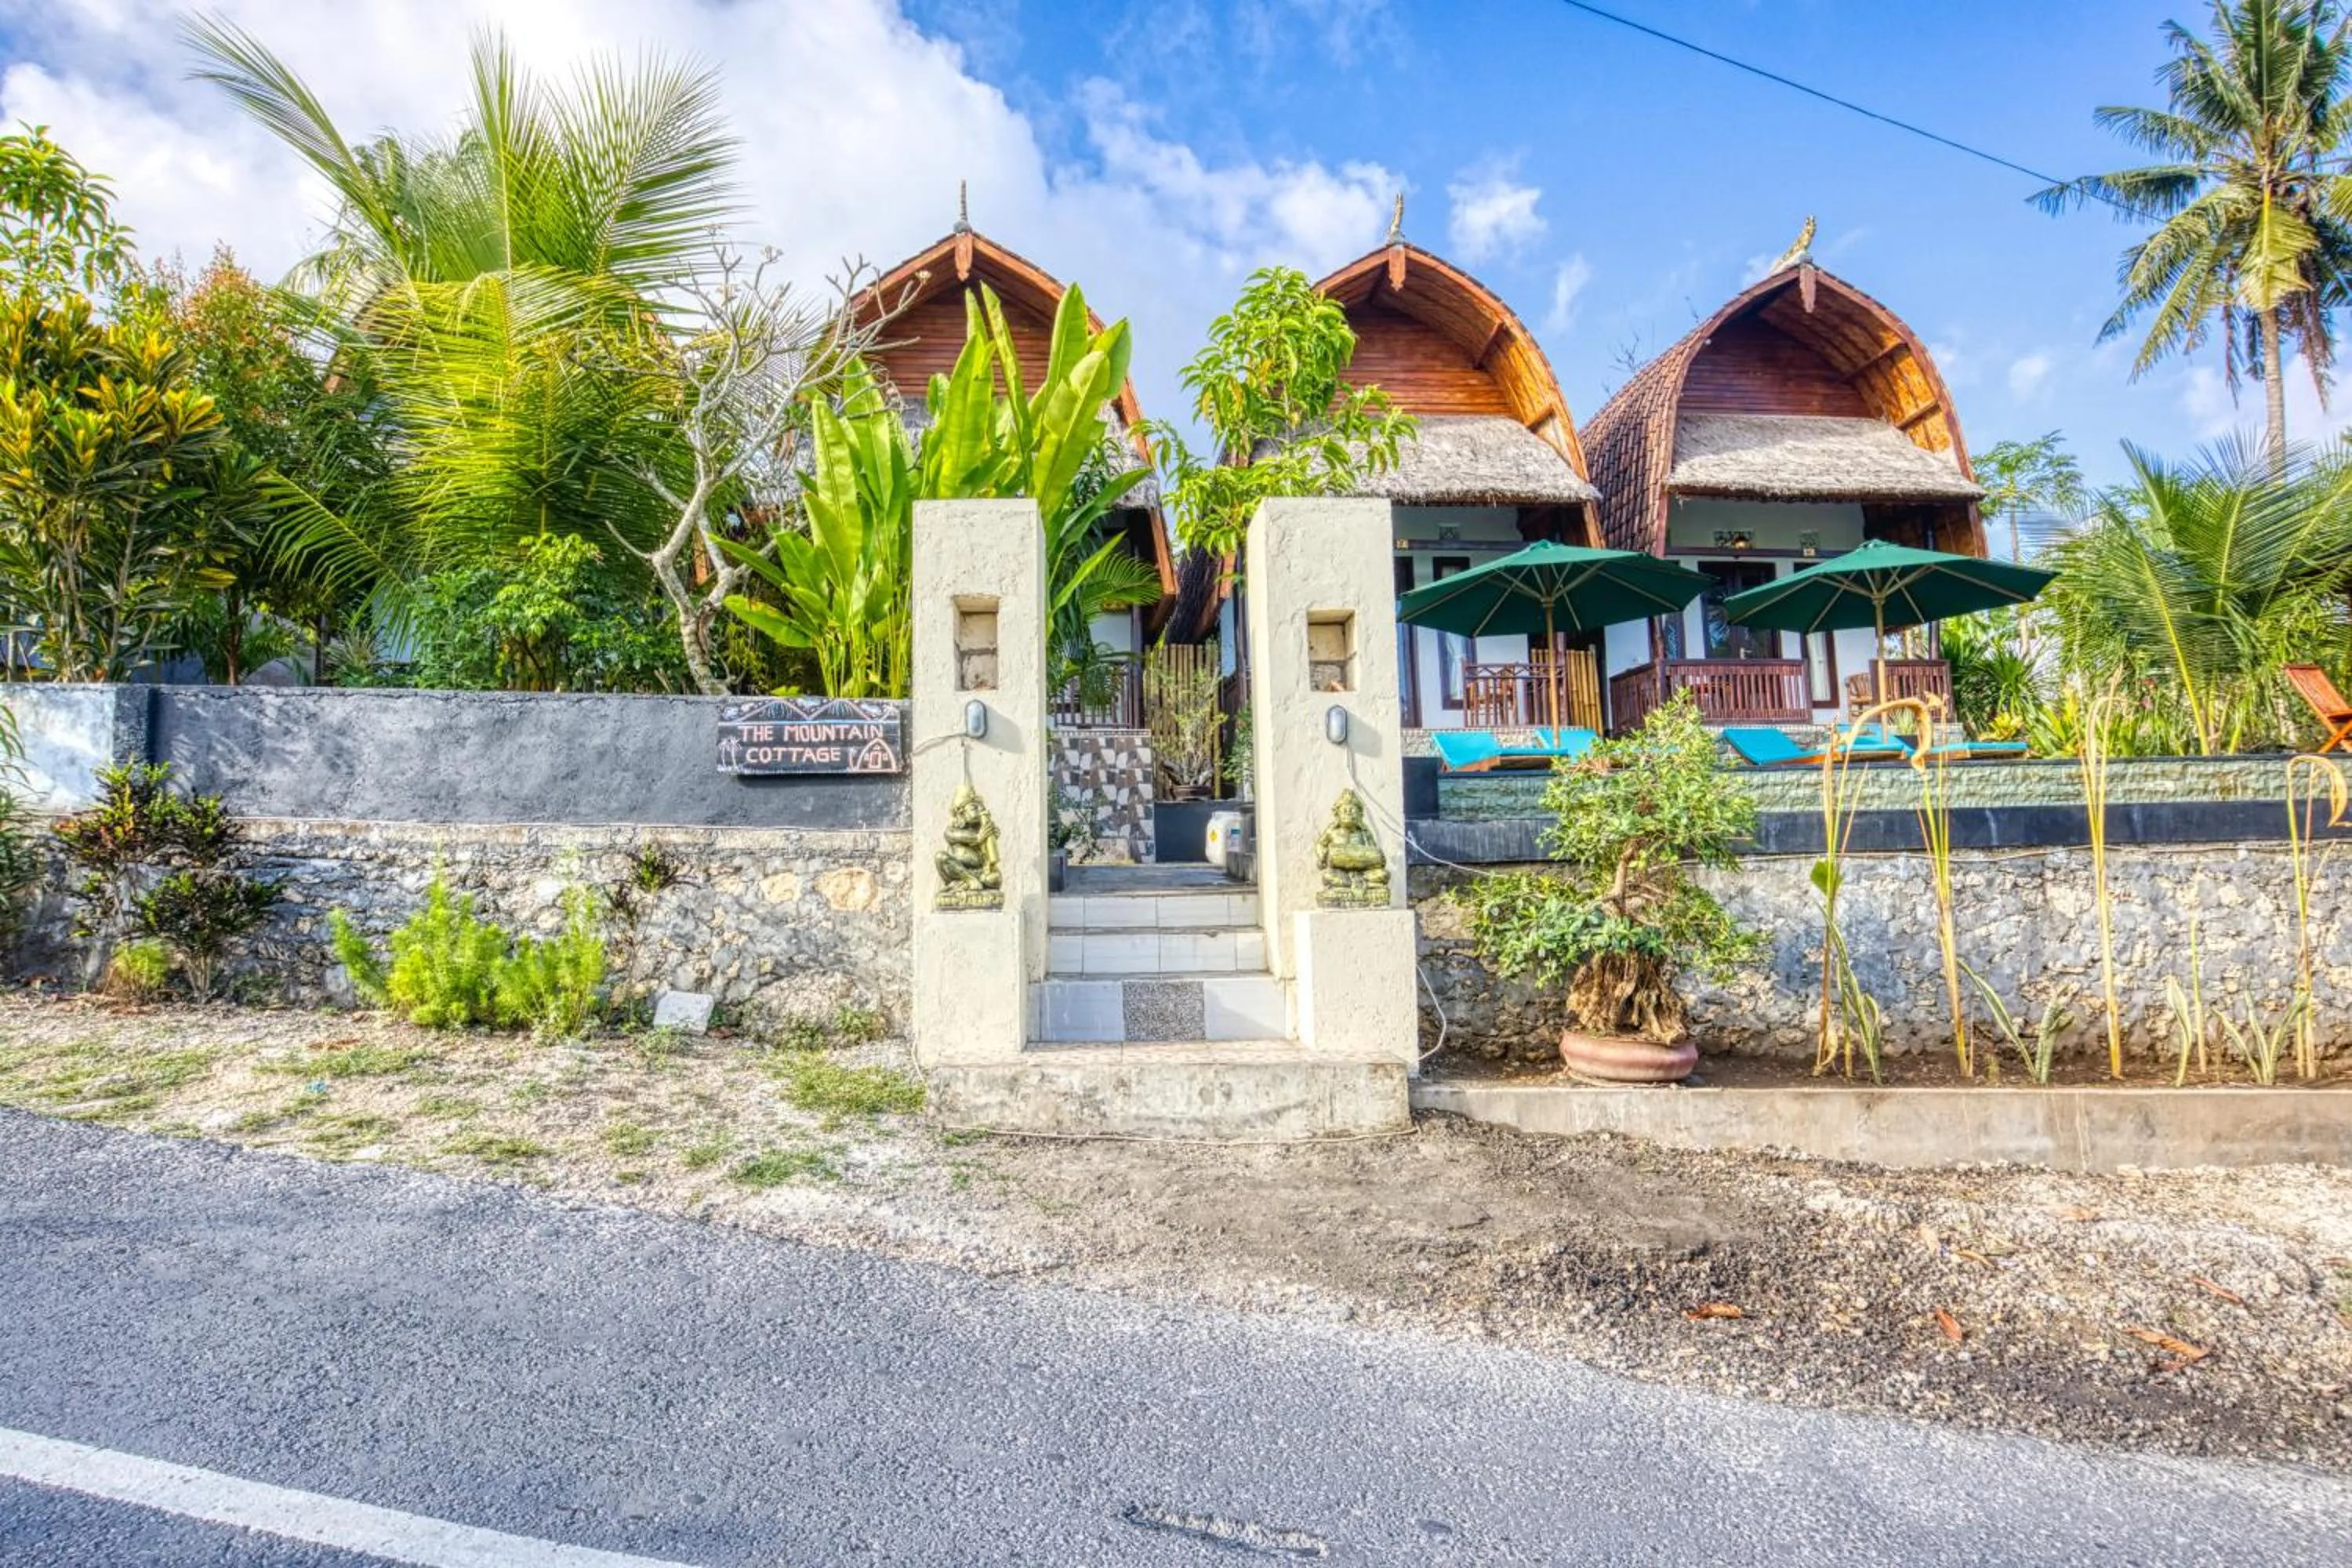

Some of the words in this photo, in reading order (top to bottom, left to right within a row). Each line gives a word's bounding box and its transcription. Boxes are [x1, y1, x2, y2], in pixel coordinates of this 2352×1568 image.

[738, 724, 774, 742] THE
[783, 724, 884, 742] MOUNTAIN
[746, 746, 841, 764] COTTAGE
